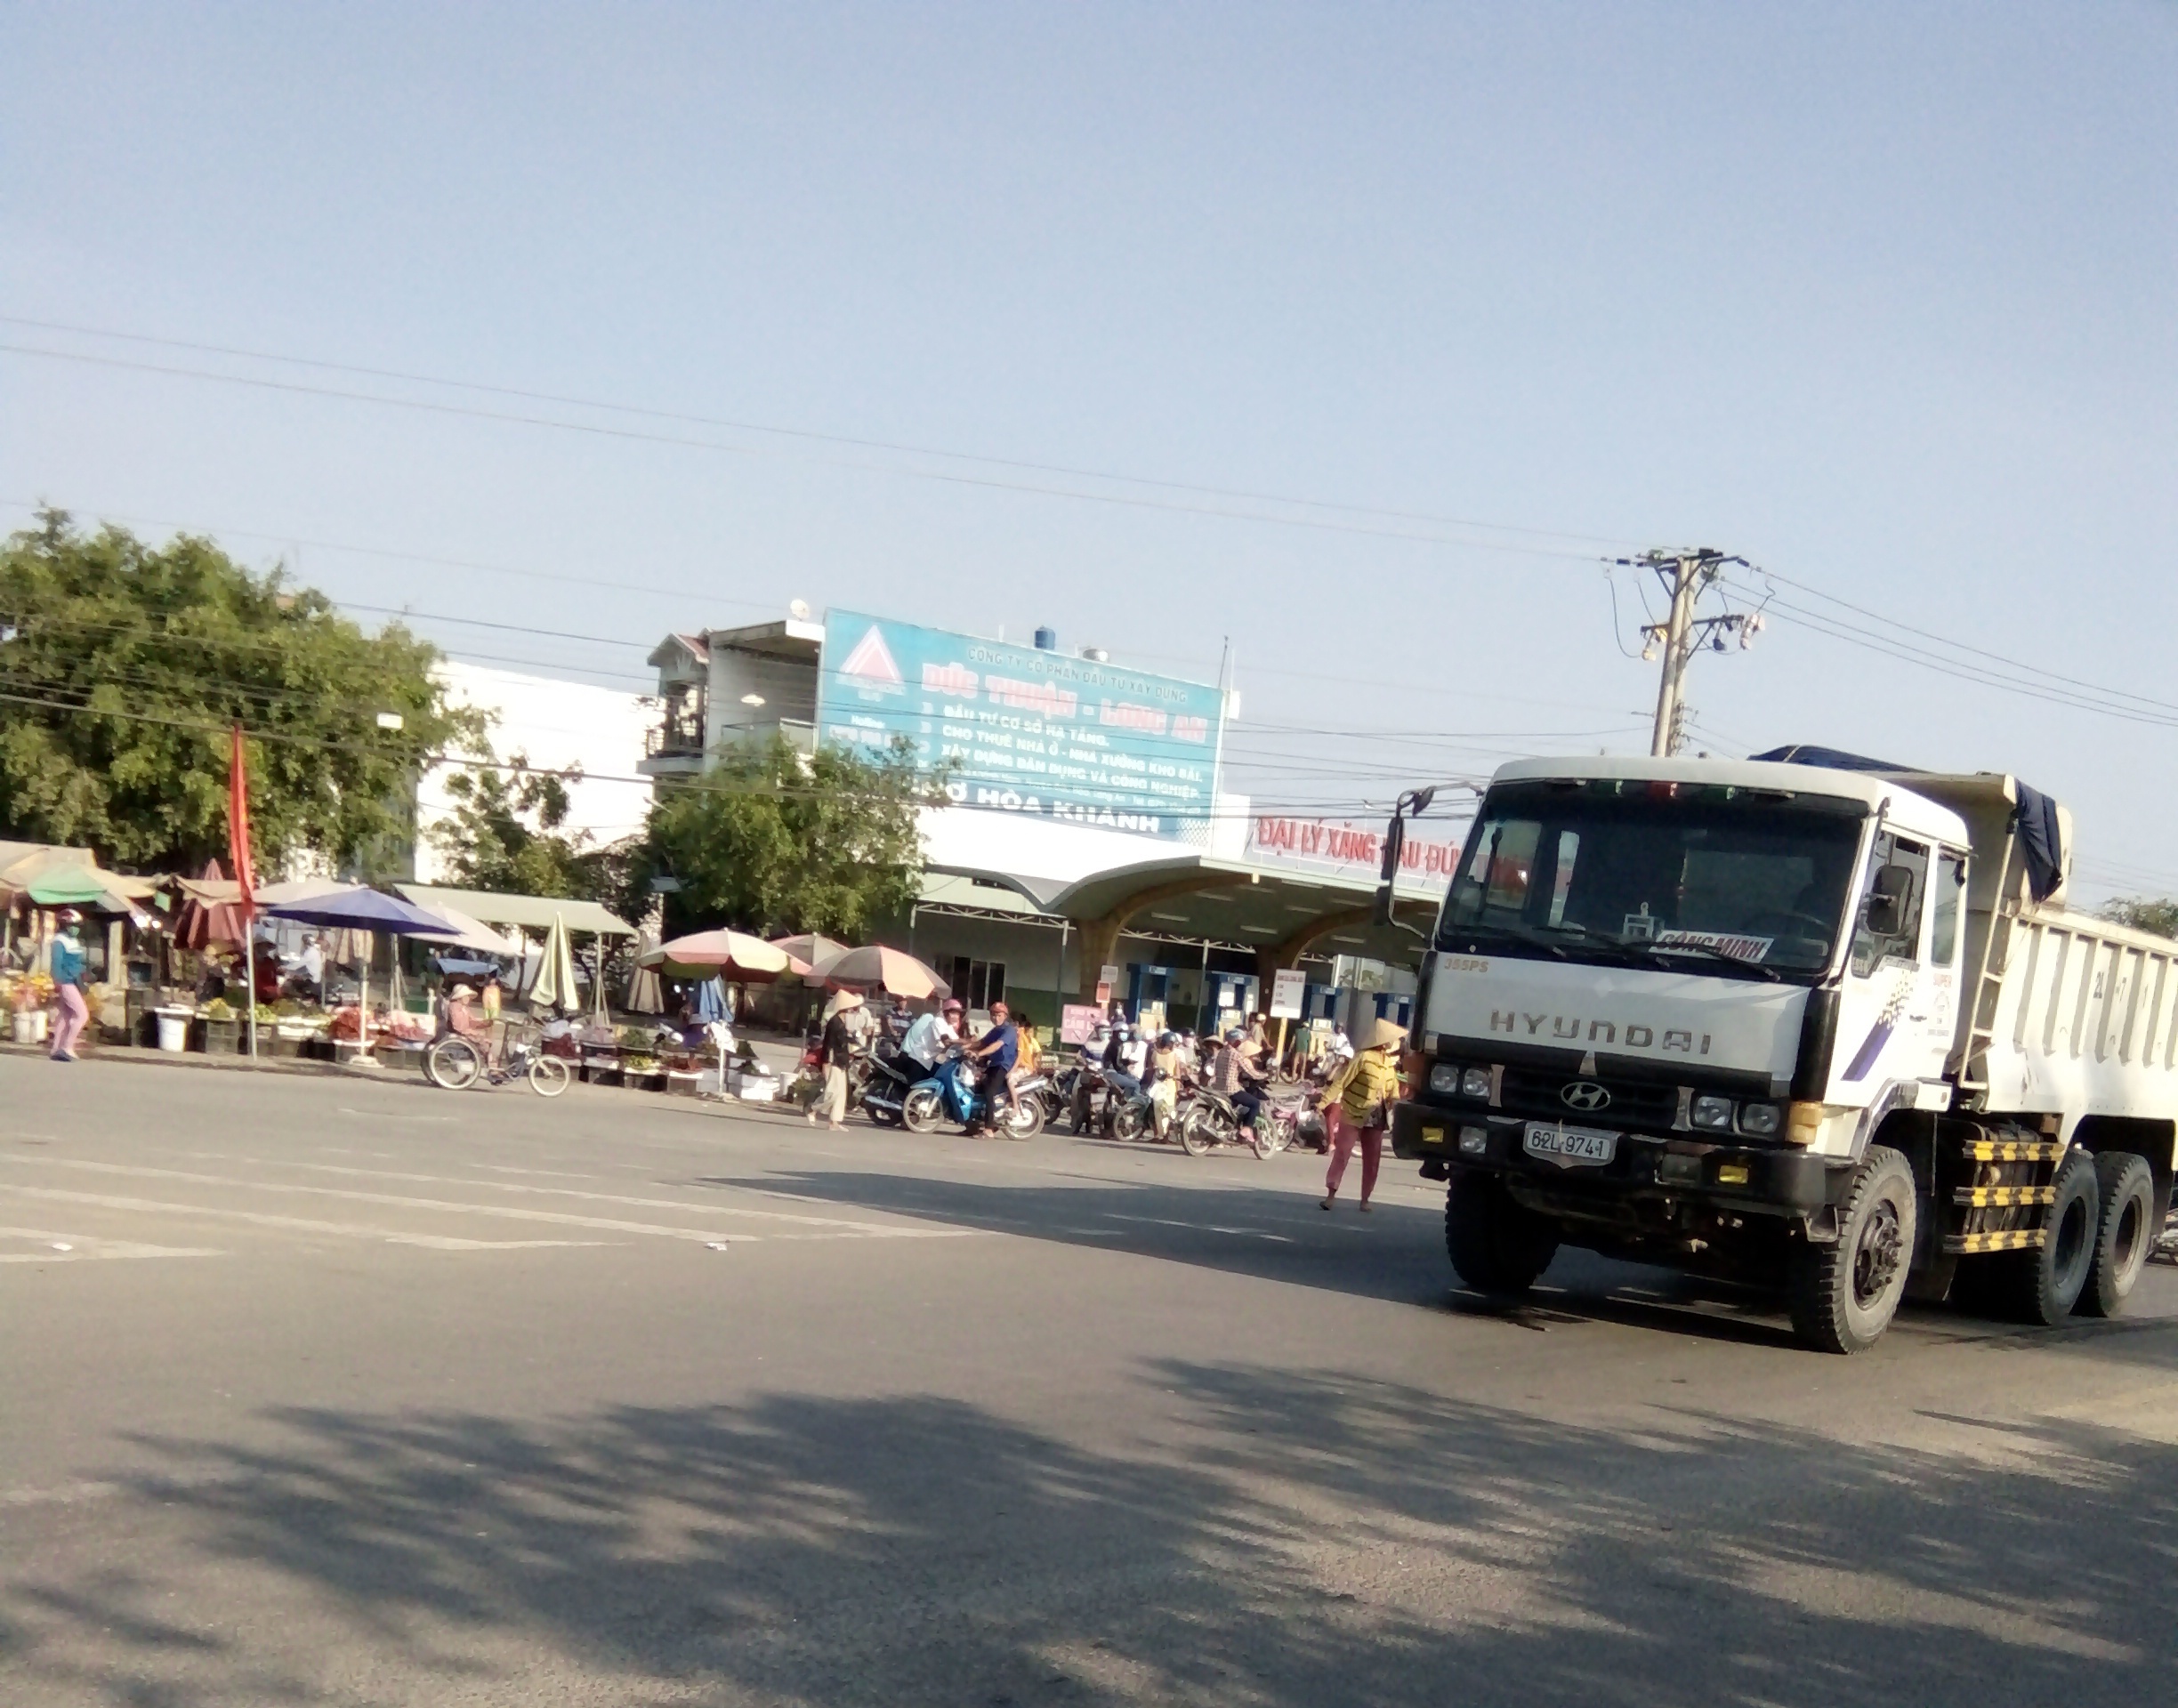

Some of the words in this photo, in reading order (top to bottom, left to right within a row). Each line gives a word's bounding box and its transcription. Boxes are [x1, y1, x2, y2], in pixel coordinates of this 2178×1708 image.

[968, 646, 1003, 665] CÔNG
[1007, 656, 1022, 667] TY
[942, 724, 973, 741] CHO
[1149, 761, 1176, 777] KHO
[1258, 816, 1296, 857] ĐẠI
[1301, 818, 1324, 855] LÝ
[1326, 821, 1377, 865] XĂNG
[1425, 840, 1464, 875] ĐỨ
[1444, 958, 1489, 973] 355PS
[1489, 1009, 1712, 1055] HYUNDAI
